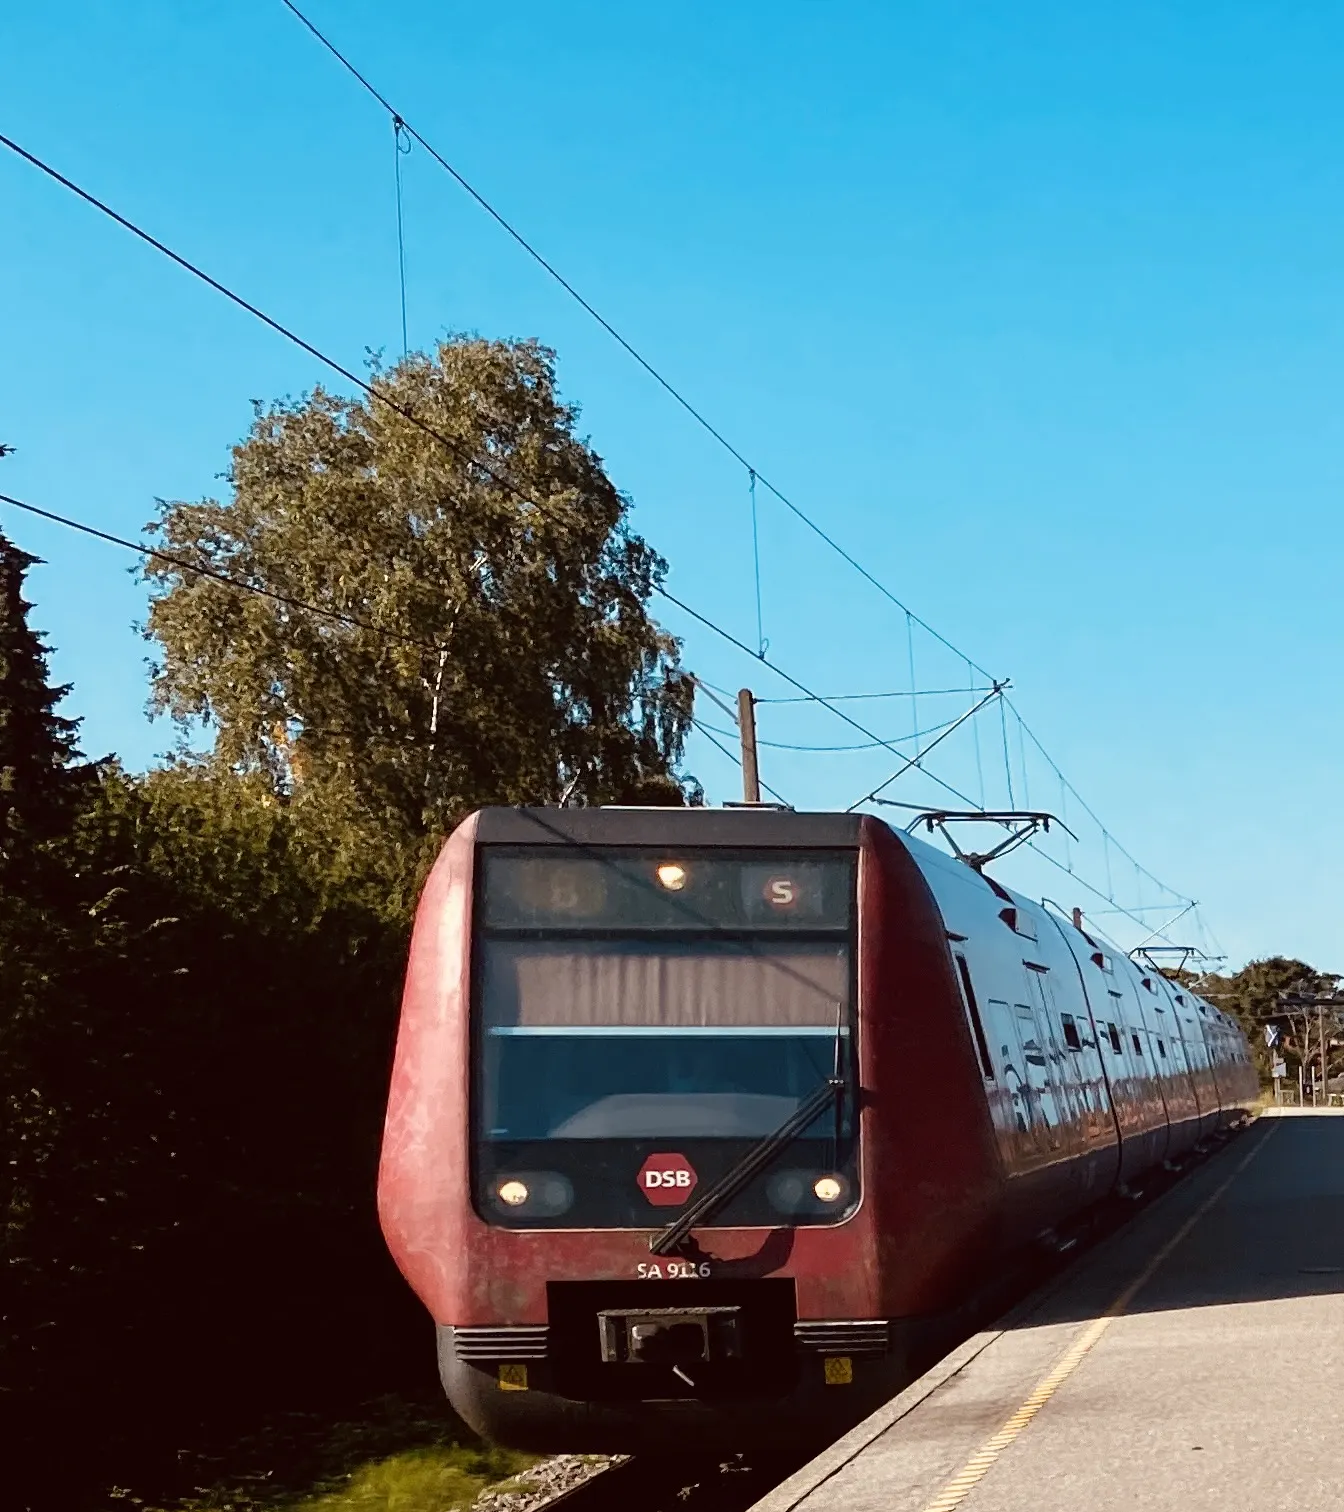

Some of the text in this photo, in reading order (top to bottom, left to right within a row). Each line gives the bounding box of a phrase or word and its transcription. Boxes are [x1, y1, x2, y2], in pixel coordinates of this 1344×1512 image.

[772, 881, 793, 904] S
[645, 1170, 691, 1188] DSB
[637, 1262, 663, 1280] SA
